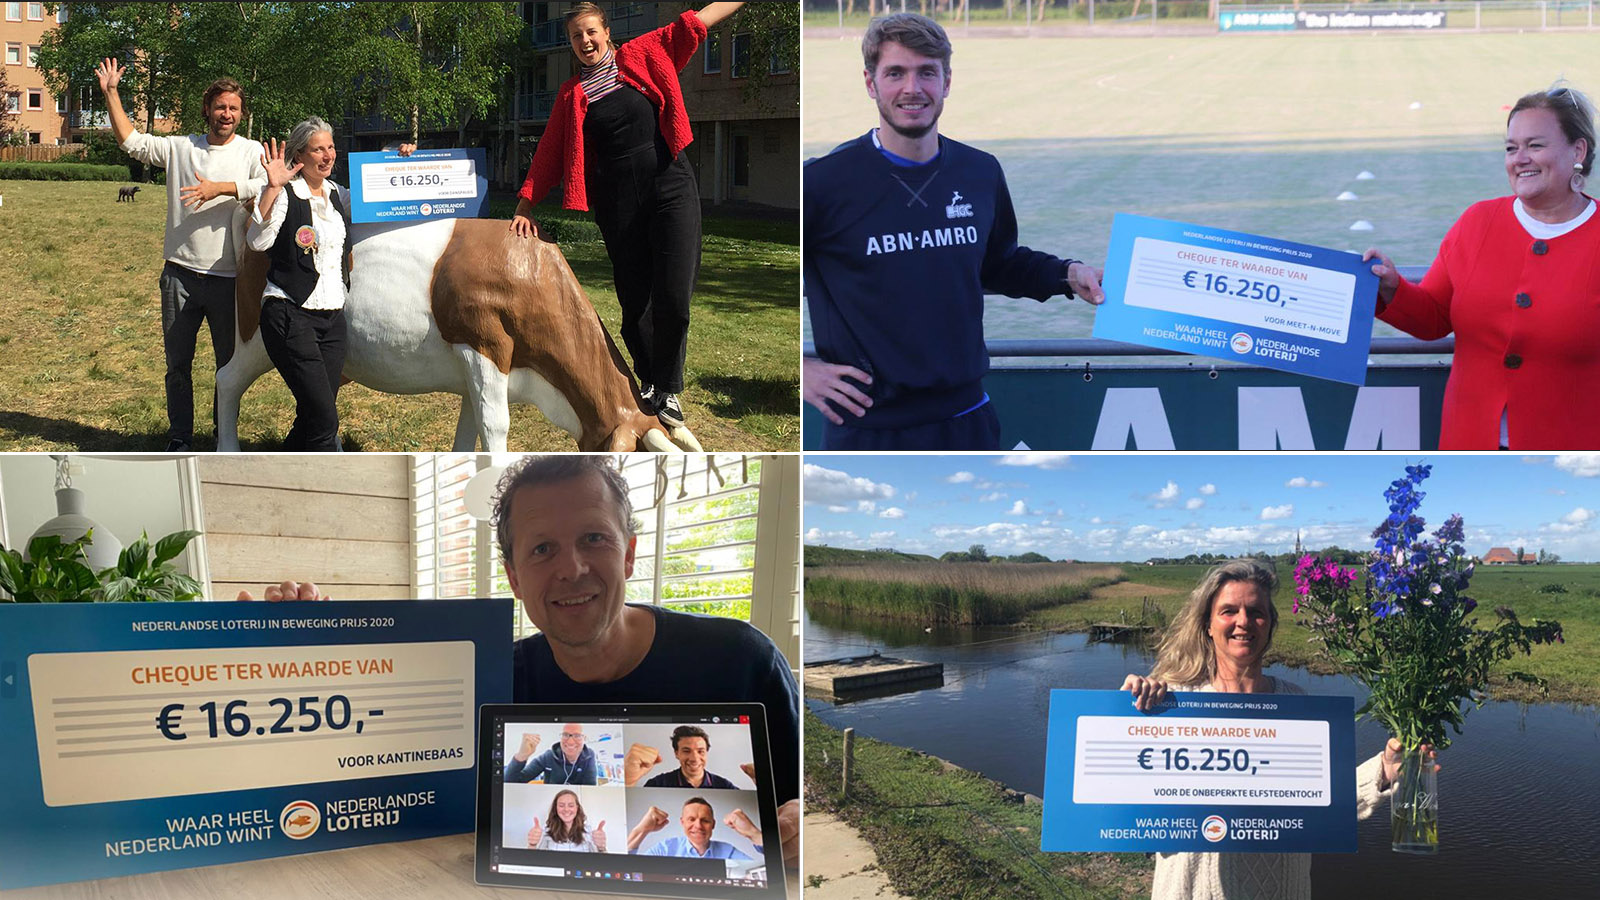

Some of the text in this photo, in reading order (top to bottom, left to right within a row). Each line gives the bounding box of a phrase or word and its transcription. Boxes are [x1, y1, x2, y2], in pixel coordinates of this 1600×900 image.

[390, 174, 448, 186] € 16.250,-
[1183, 231, 1223, 243] NEDERLANDSE
[1224, 238, 1246, 248] LOTERIJ
[1253, 242, 1282, 254] BEWEGING
[1282, 248, 1298, 256] PRIJS
[1298, 250, 1312, 259] 2020
[1177, 251, 1308, 281] CHEQUE TER WAARDE VAN
[1183, 270, 1298, 308] € 16.250,-
[1174, 323, 1228, 340] WAAR HEEL
[1264, 316, 1341, 336] VOOR MEET-N-MOVE
[1143, 327, 1228, 349] NEDERLAND WINT
[1256, 338, 1320, 358] NEDERLANDSE
[1254, 348, 1298, 362] LOTERIJ
[132, 617, 395, 632] NEDERLANDSE LOTERIJ IN BEWEGING PRIJS 2020
[131, 658, 394, 686] CHEQUE TER WAARDE VAN
[156, 694, 384, 740] € 16.250,-
[1128, 726, 1277, 738] CHEQUE TER WAARDE VAN
[338, 747, 464, 769] VOOR KANTINEBAAS
[1137, 748, 1270, 775] € 16.250,-
[325, 791, 436, 815] NEDERLANDSE
[1154, 788, 1178, 797] VOOR
[1192, 789, 1248, 797] ONBEPERKTE
[1249, 790, 1322, 798] ELFSTEDENTOCHT
[166, 809, 274, 834] WAAR HEEL
[326, 809, 400, 833] LOTERIJ
[1136, 818, 1198, 828] WAAR HEEL
[1231, 819, 1304, 829] NEDERLANDSE
[105, 826, 274, 857] NEDERLAND WINT
[1100, 829, 1198, 839] NEDERLAND WINT
[1231, 830, 1279, 840] LOTERIJ
